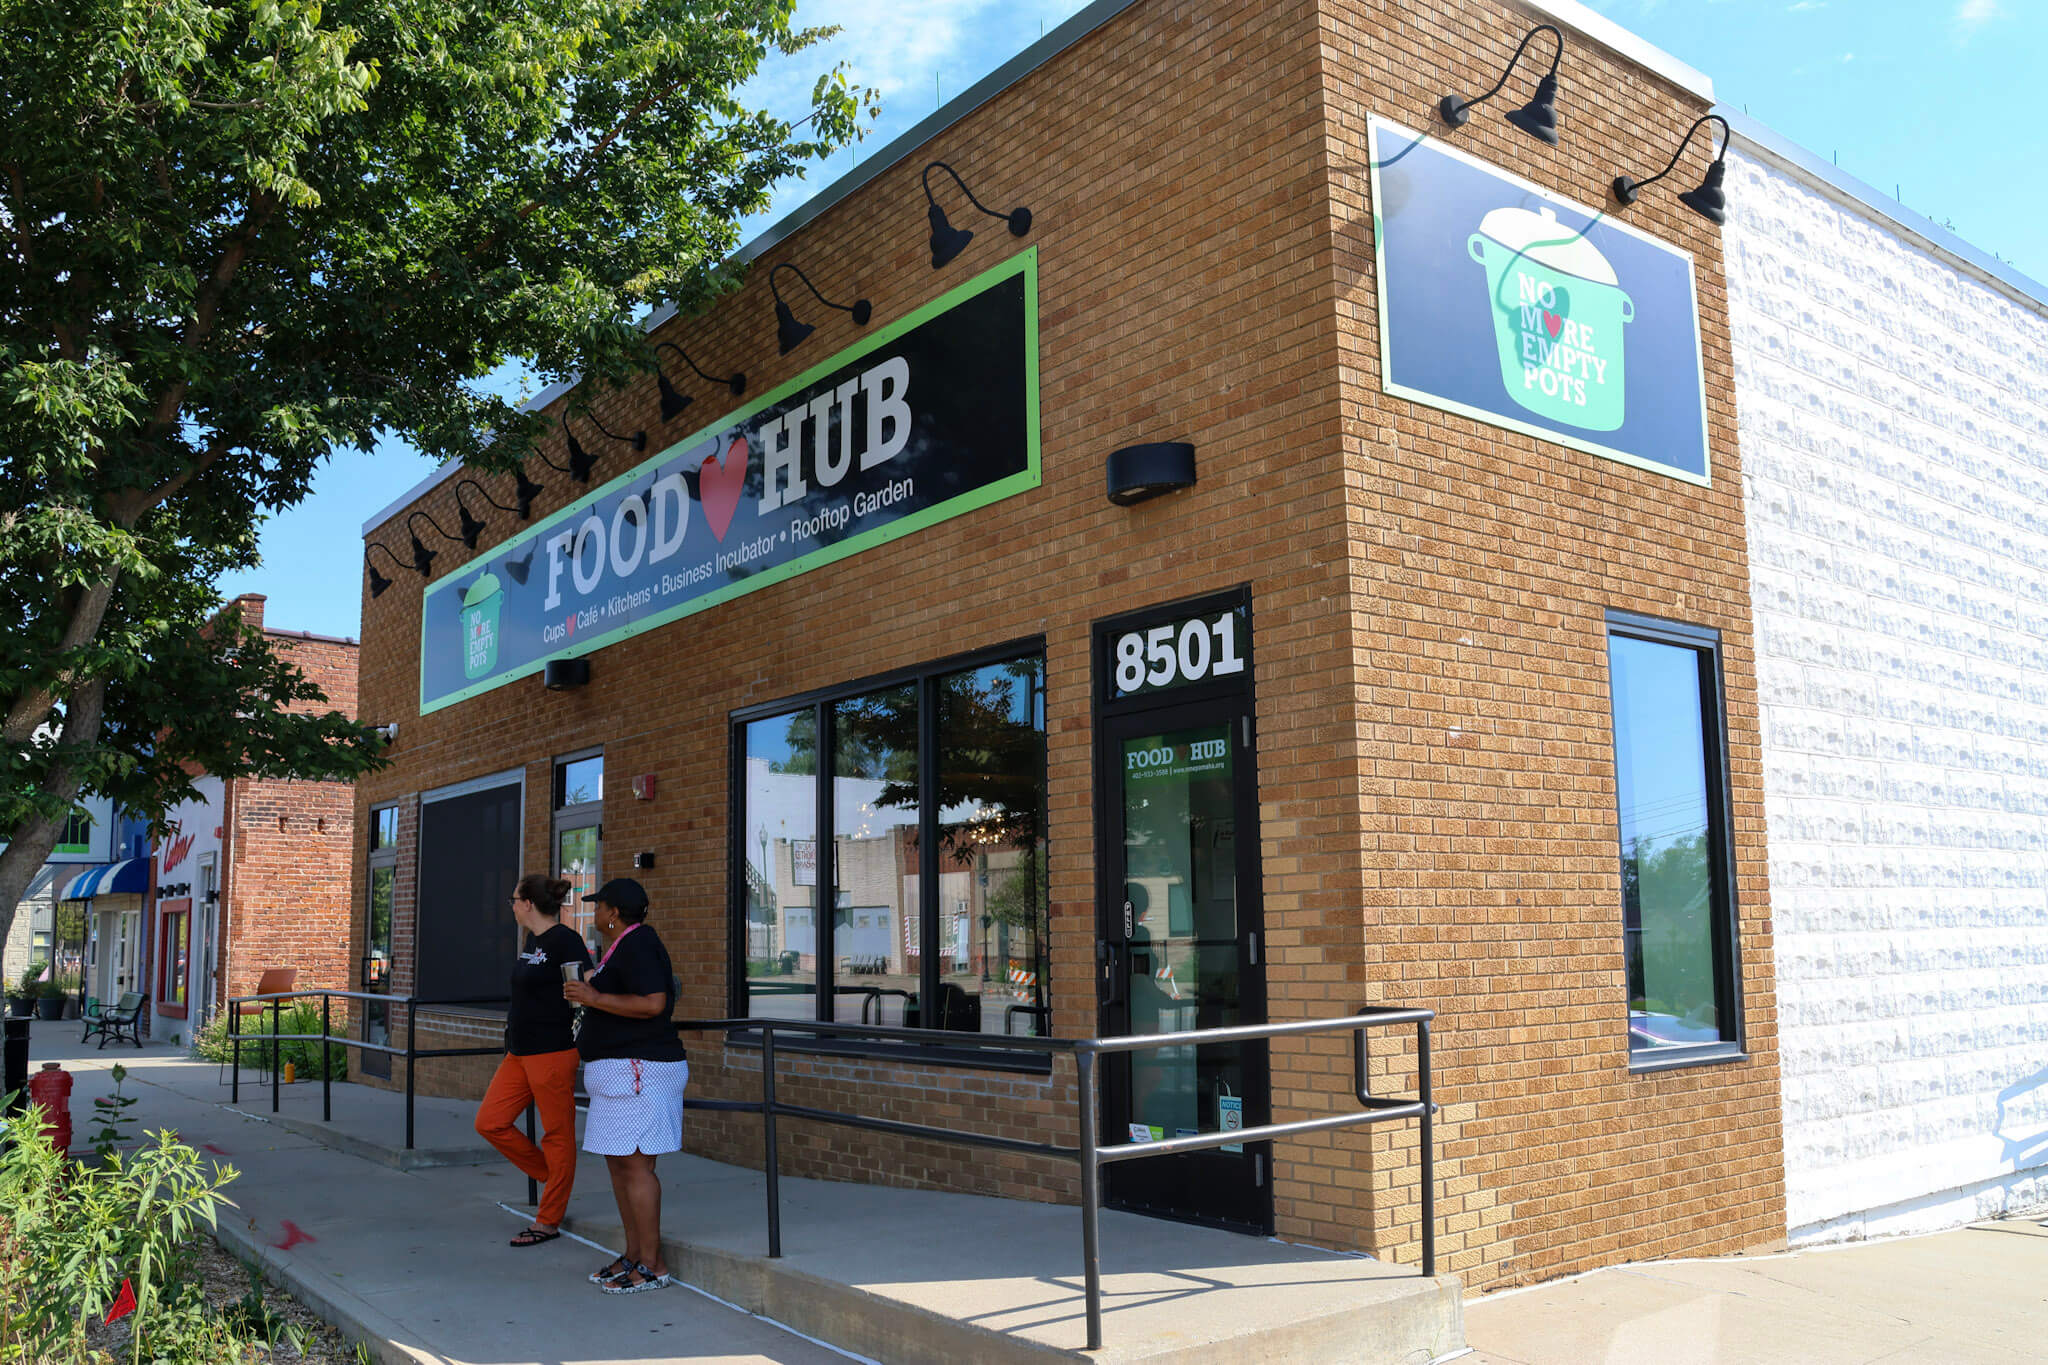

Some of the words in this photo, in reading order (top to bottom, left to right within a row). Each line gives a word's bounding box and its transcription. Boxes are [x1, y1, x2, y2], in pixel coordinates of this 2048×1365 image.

[1518, 271, 1557, 309] NO
[1521, 331, 1607, 385] EMPTY
[1523, 361, 1587, 407] POTS
[543, 472, 690, 612] FOOD
[758, 356, 913, 516] HUB
[543, 623, 566, 643] Cups
[577, 605, 598, 630] Café
[608, 587, 650, 617] Kitchens
[662, 560, 713, 596] Business
[716, 534, 777, 573] Incubator
[791, 506, 850, 544] Rooftop
[853, 477, 914, 518] Garden
[470, 610, 481, 625] NO
[469, 632, 494, 655] EMPTY
[469, 650, 487, 672] POTS
[1115, 611, 1244, 692] 8501
[1126, 747, 1174, 769] FOOD
[1190, 739, 1226, 761] HUB
